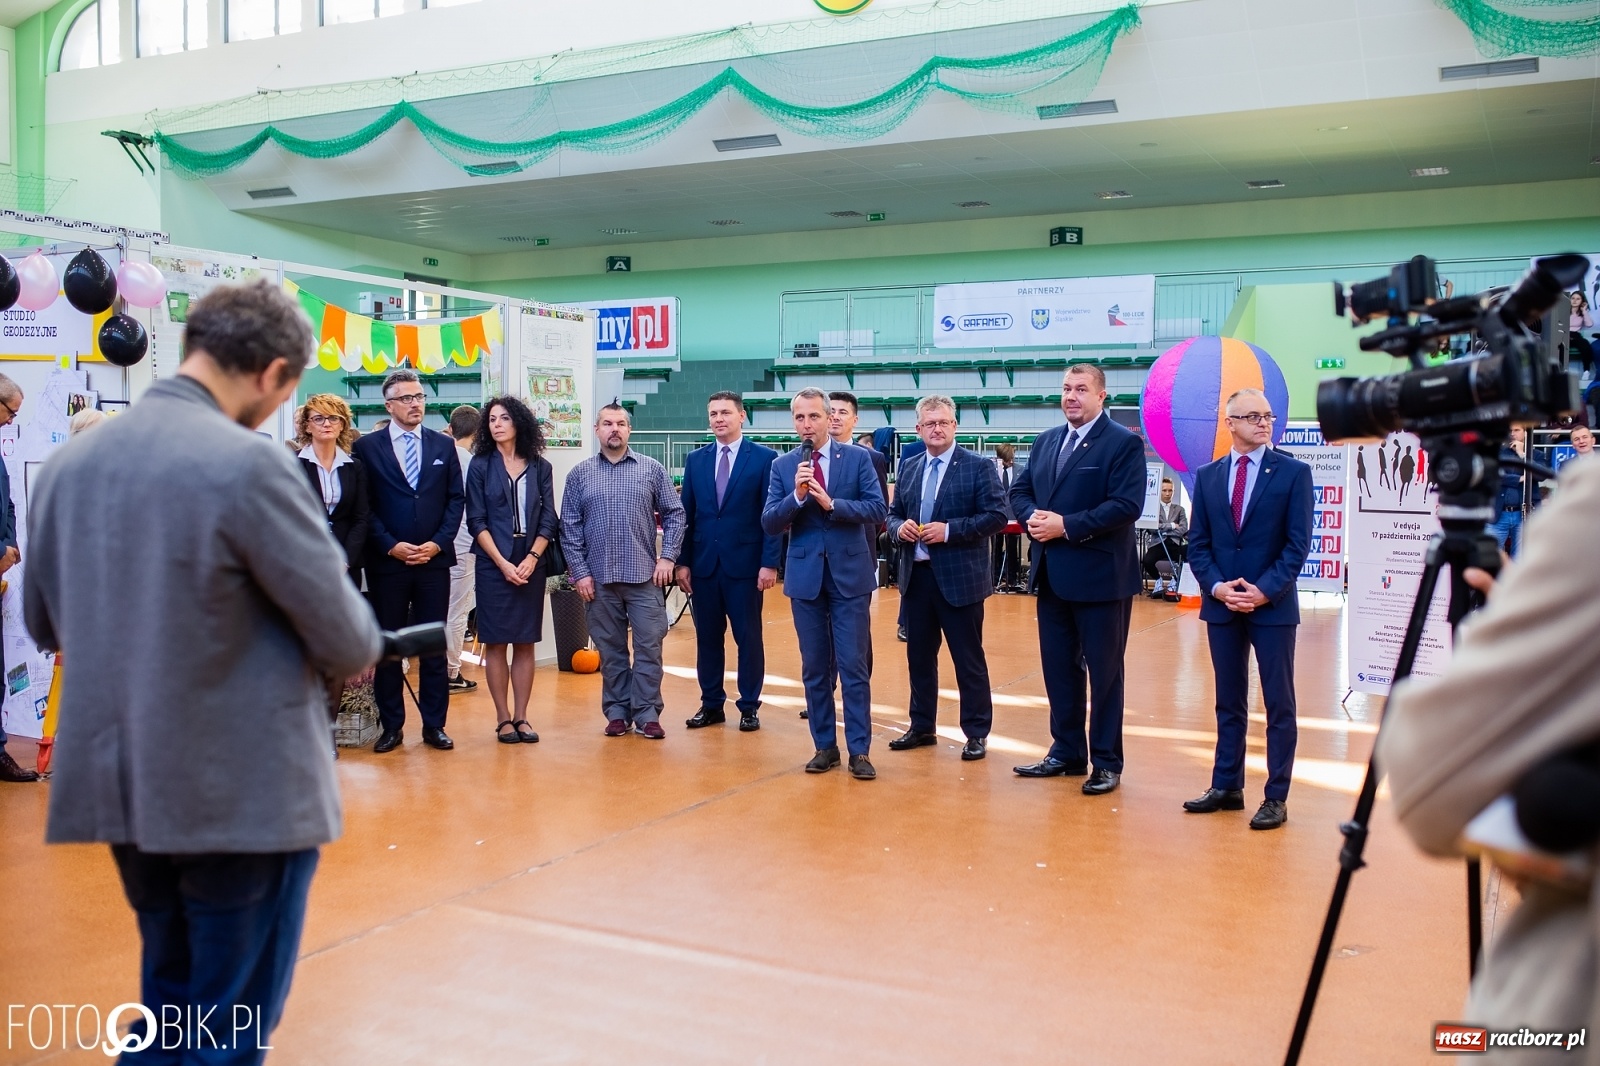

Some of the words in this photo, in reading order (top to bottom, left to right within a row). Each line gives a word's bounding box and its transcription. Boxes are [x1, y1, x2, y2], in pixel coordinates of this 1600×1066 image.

[1052, 234, 1059, 244] B
[1066, 232, 1078, 243] B
[613, 261, 627, 270] A
[1017, 287, 1065, 296] PARTNERZY
[3, 310, 36, 321] STUDIO
[1055, 308, 1091, 316] Województwo
[597, 304, 664, 350] iny.pl
[963, 317, 1008, 328] RAFAMET
[3, 326, 58, 337] GEODEZYJNE
[1317, 452, 1342, 461] portal
[1315, 463, 1342, 471] Polsce
[1400, 522, 1421, 530] edycja
[1379, 533, 1421, 541] października
